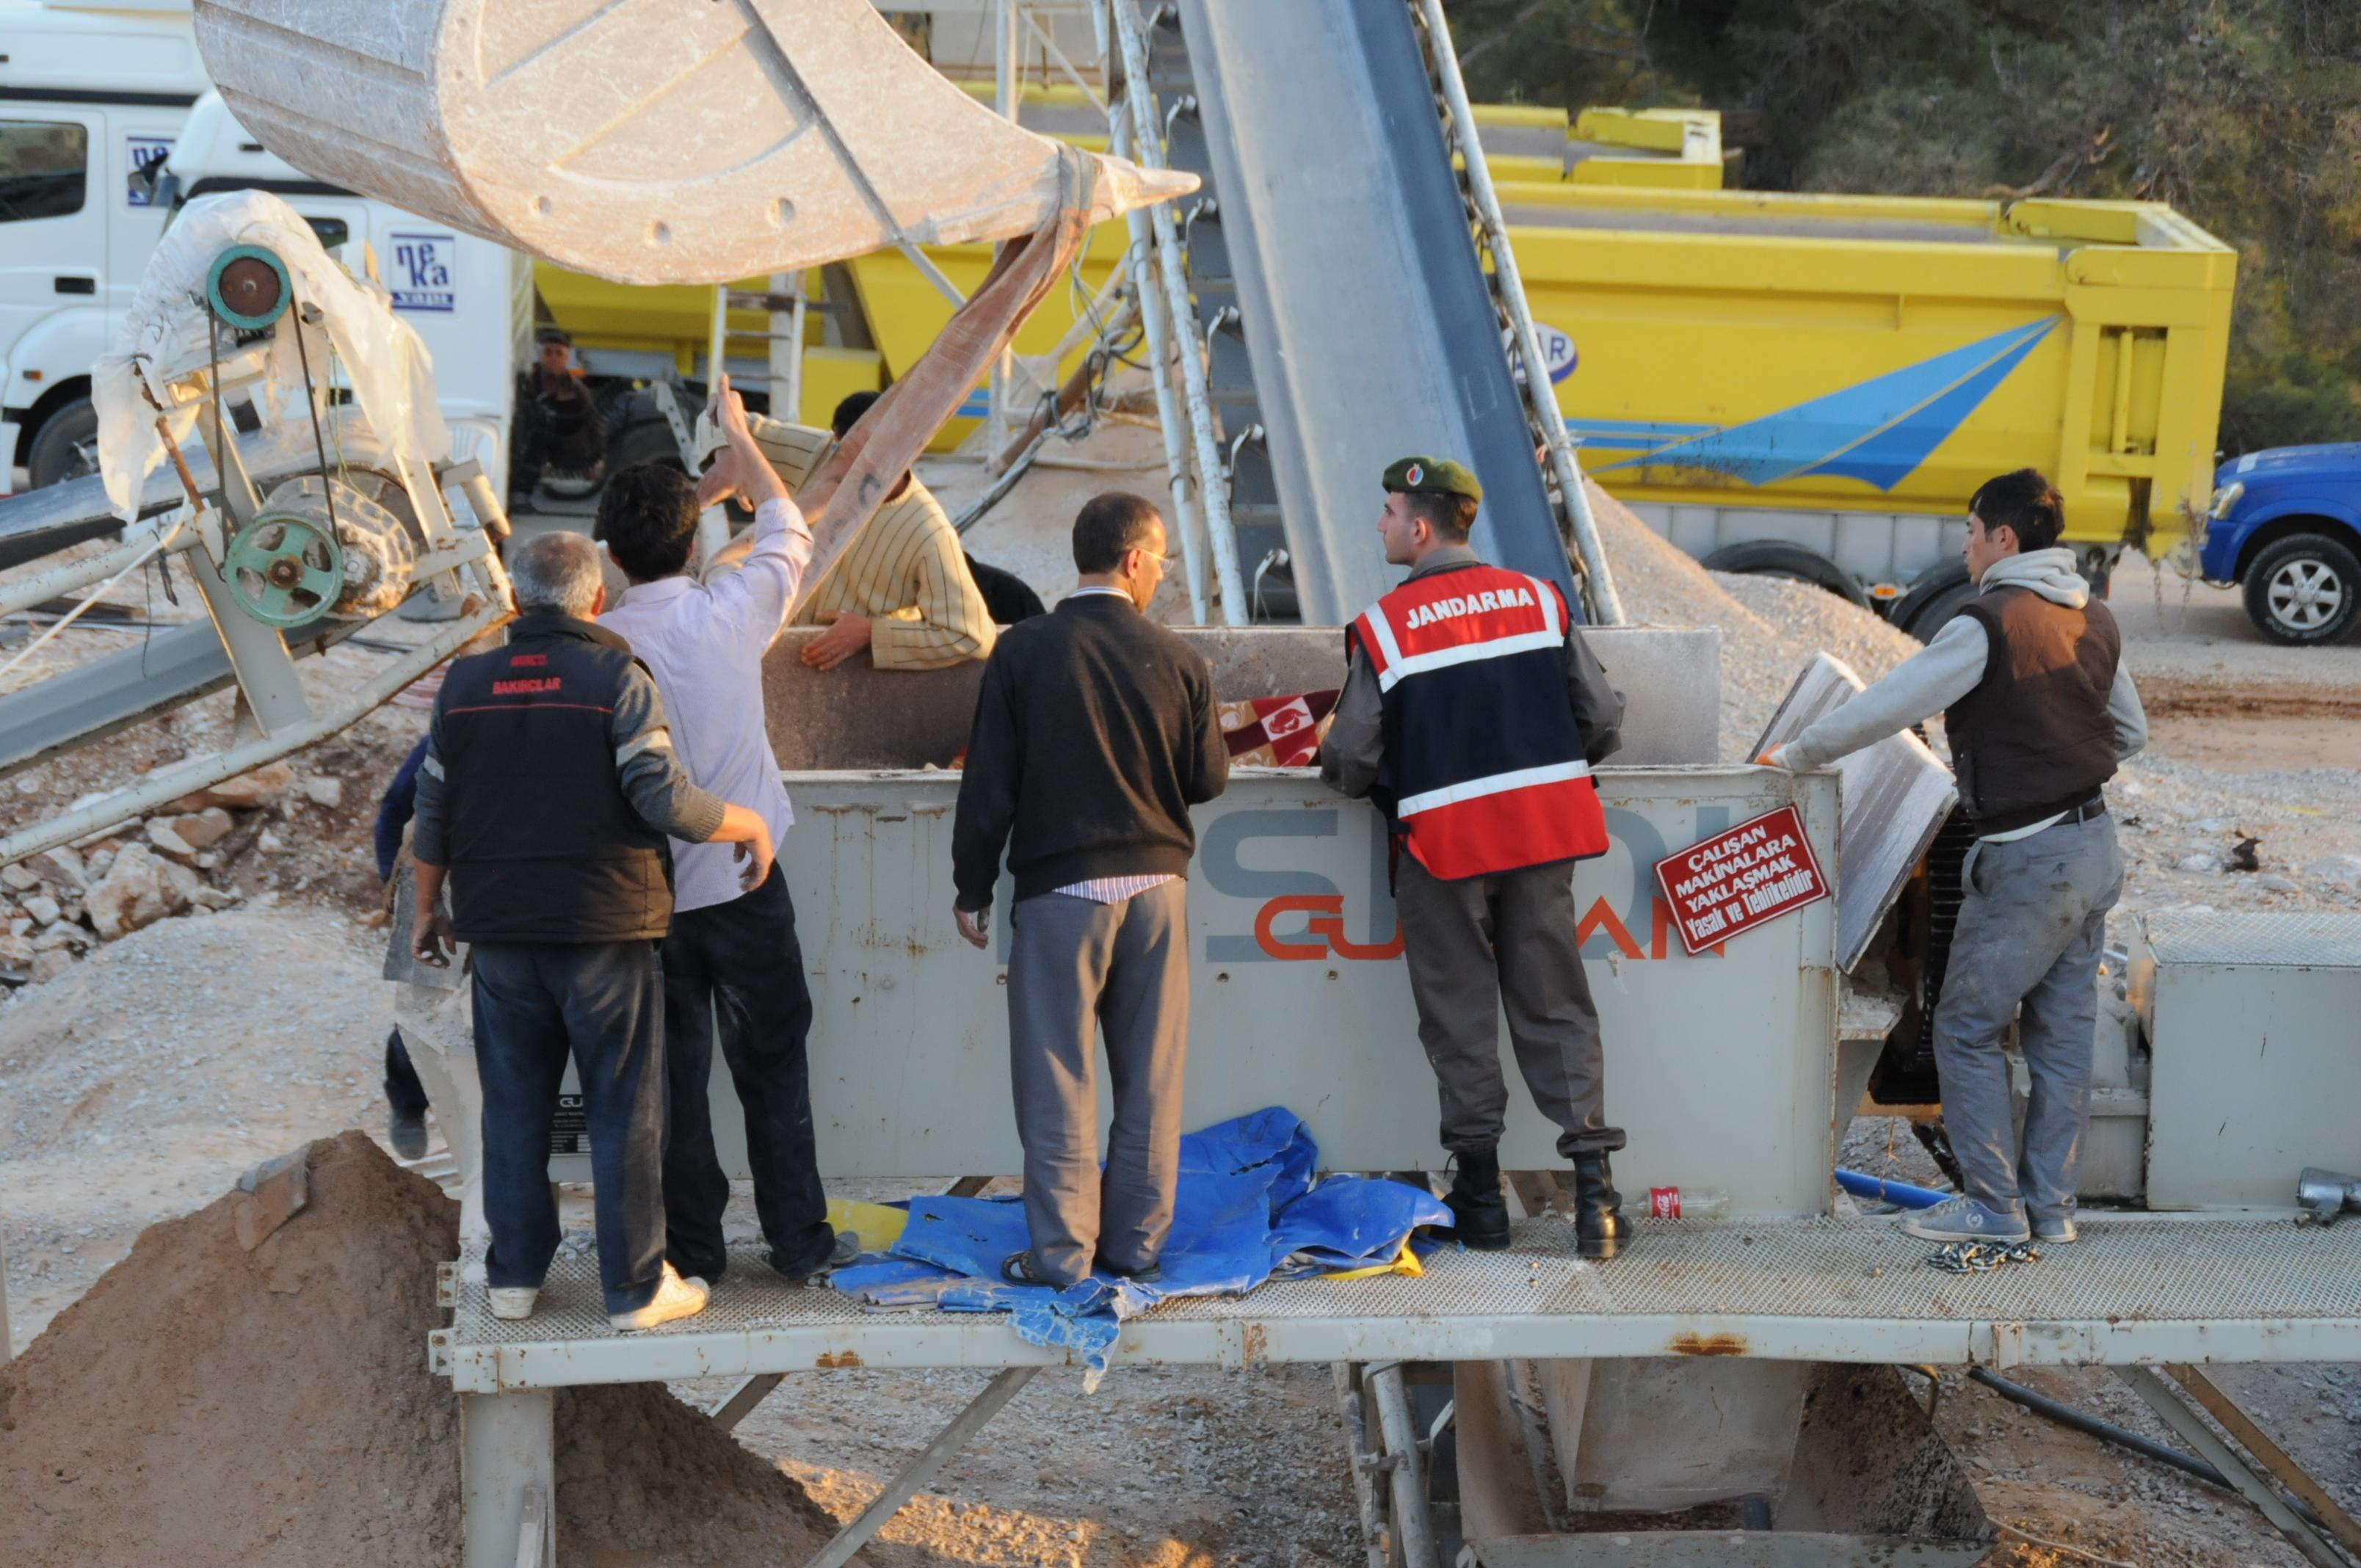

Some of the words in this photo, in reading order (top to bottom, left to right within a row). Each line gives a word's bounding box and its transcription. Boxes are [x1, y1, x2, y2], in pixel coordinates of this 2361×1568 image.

[1406, 587, 1536, 629] JANDARMA
[1675, 833, 1797, 899] MAKİNALARA
[1688, 824, 1767, 872] ÇALIŞAN
[1685, 853, 1797, 914] YAKLAŞMAK
[1686, 907, 1727, 942] Yasak
[1725, 901, 1745, 923] ve
[1741, 868, 1815, 916] Tehlikelidir
